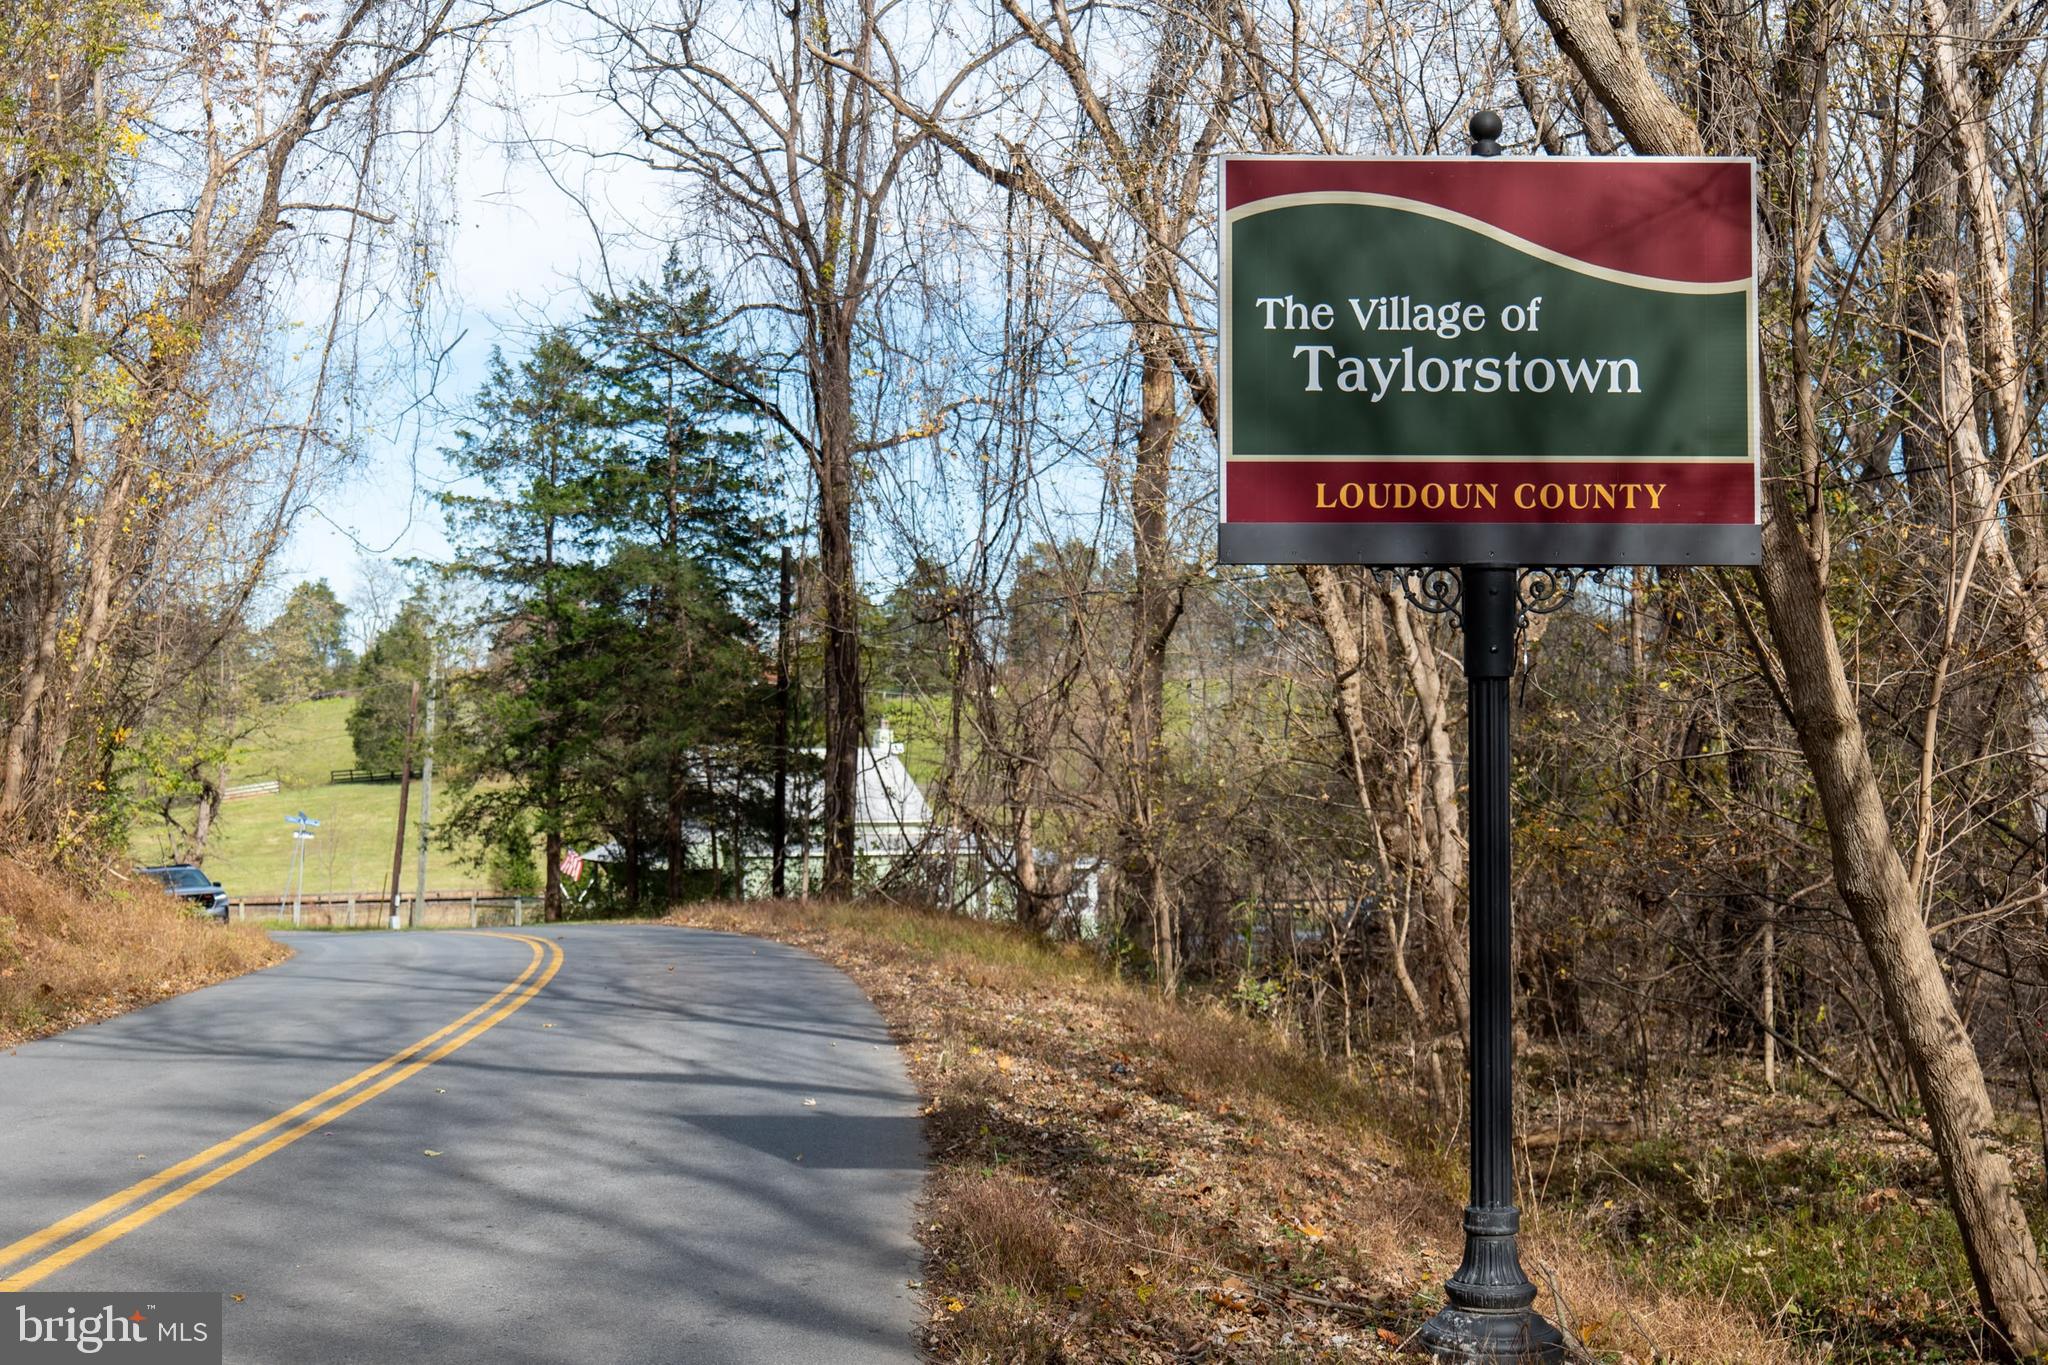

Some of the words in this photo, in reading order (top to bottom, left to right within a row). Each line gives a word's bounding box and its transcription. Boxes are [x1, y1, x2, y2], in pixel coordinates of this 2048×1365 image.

[1256, 295, 1334, 331] The
[1349, 295, 1486, 339] Village
[1501, 296, 1542, 332] of
[1293, 345, 1642, 403] Taylorstown
[1316, 483, 1498, 510] LOUDOUN
[1513, 483, 1667, 510] COUNTY
